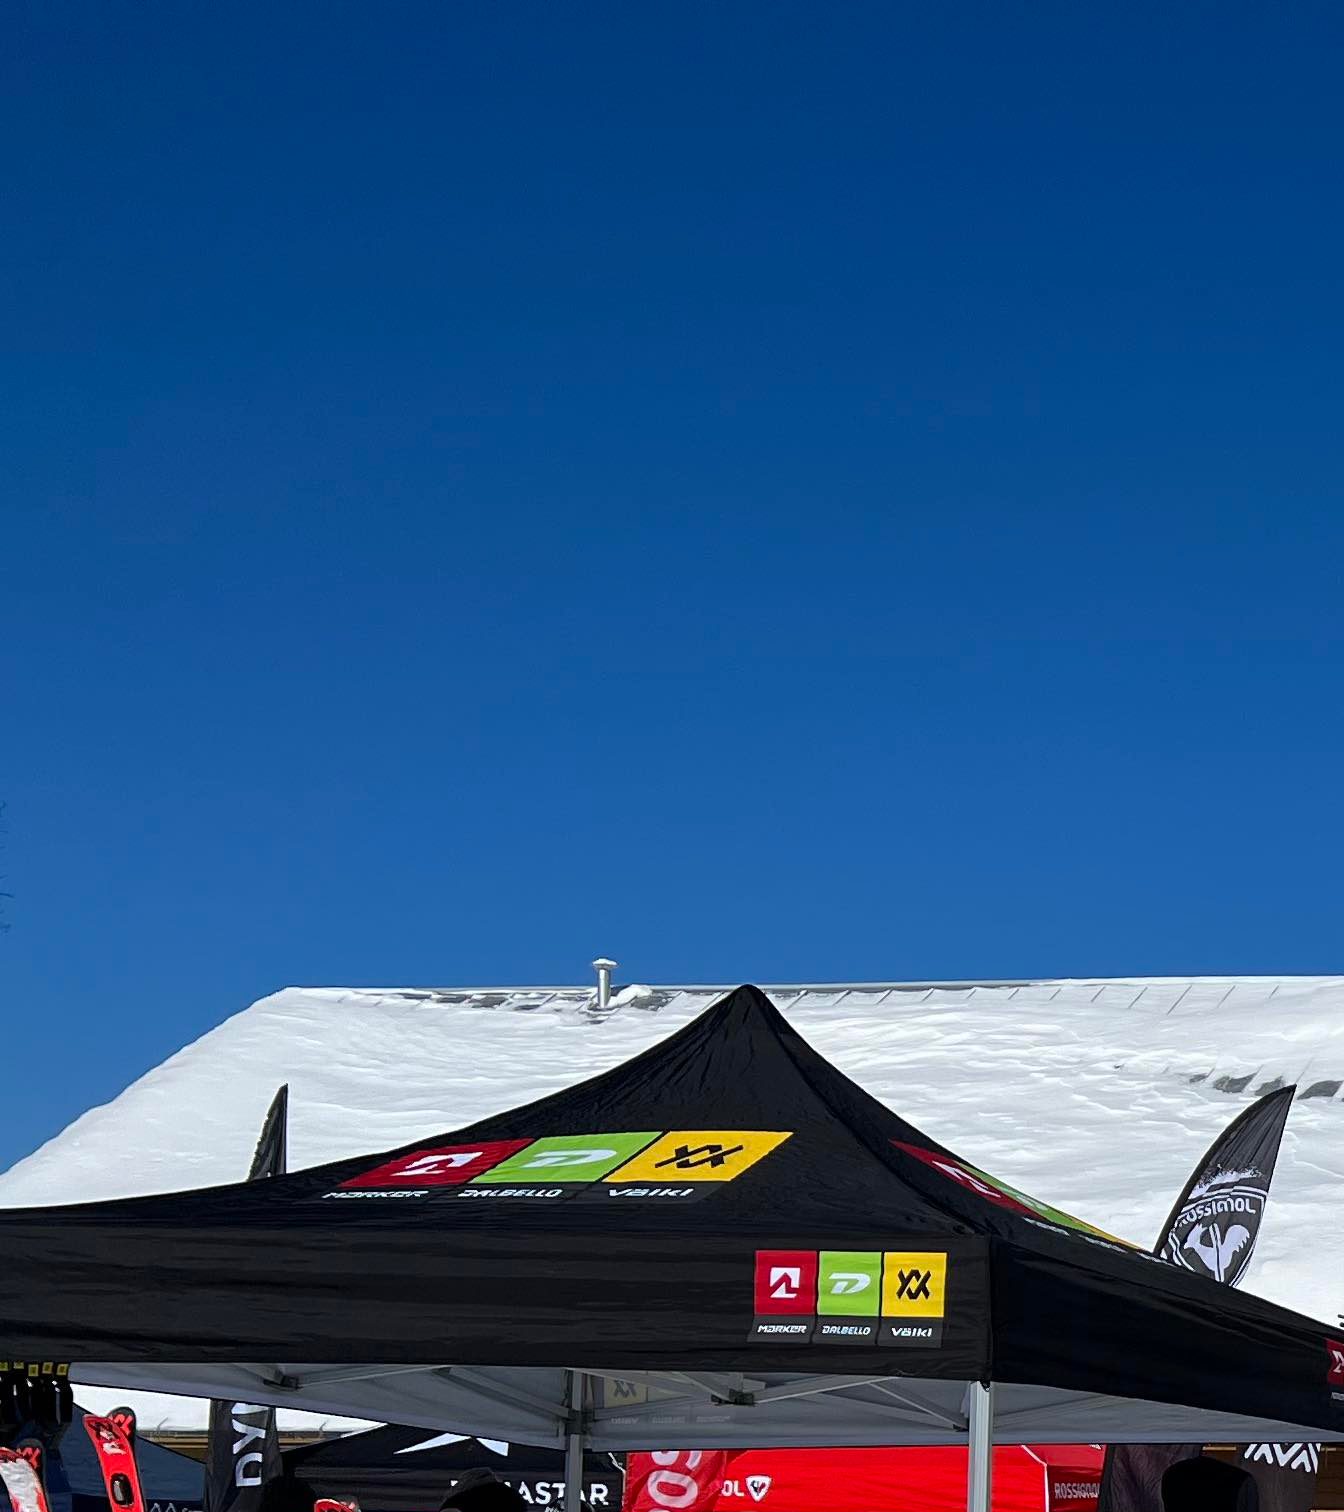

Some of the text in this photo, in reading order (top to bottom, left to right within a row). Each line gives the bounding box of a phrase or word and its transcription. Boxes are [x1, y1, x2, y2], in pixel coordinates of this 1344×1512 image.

[458, 1188, 563, 1198] DALBELLO
[757, 1325, 807, 1335] MARKER
[821, 1326, 871, 1336] DALBELLO
